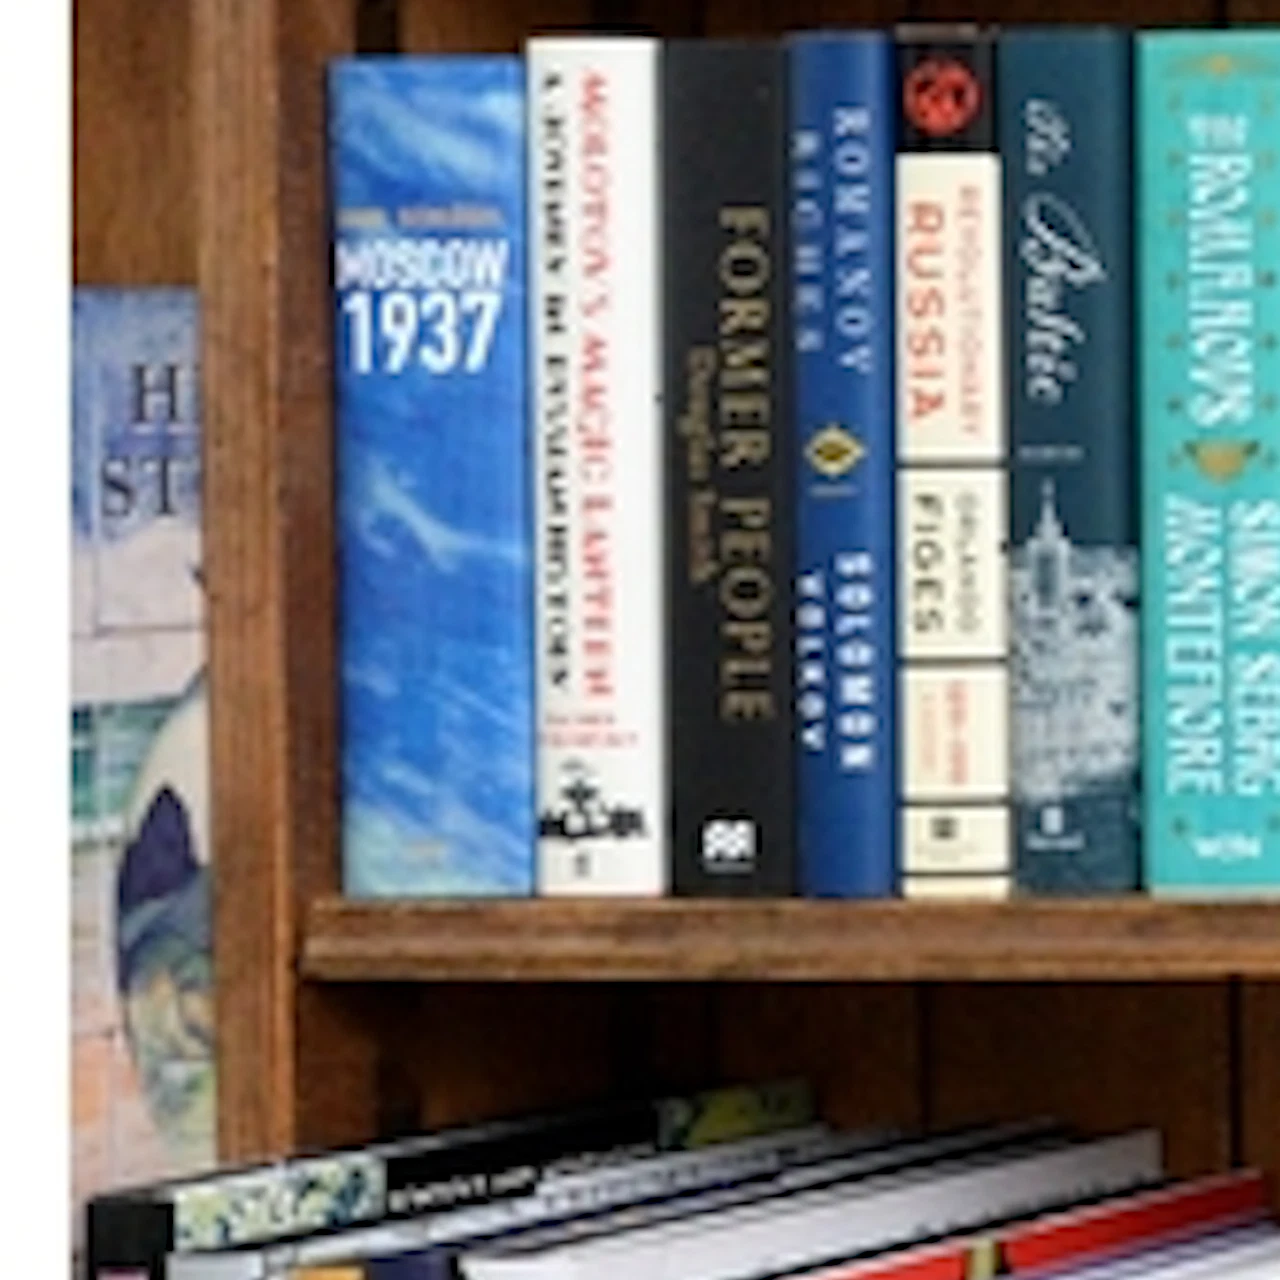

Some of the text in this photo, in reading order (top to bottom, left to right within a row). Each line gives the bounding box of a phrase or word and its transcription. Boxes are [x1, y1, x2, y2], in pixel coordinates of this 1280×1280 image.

[334, 237, 509, 290] MOSCOW
[342, 292, 502, 374] 1937
[795, 130, 825, 353] RICHES
[833, 106, 873, 375] ROMANOV
[907, 200, 946, 421] RUSSIA
[1019, 192, 1108, 406] Baltic
[1188, 153, 1255, 427] ROMANOVS
[577, 333, 611, 478] MAGIC
[717, 206, 772, 723] FORMER PEOPLE
[796, 569, 827, 751] VOLKOV
[835, 551, 876, 768] SOLOMON
[913, 493, 945, 634] FIGES
[1164, 494, 1226, 797] MONTEFIORE
